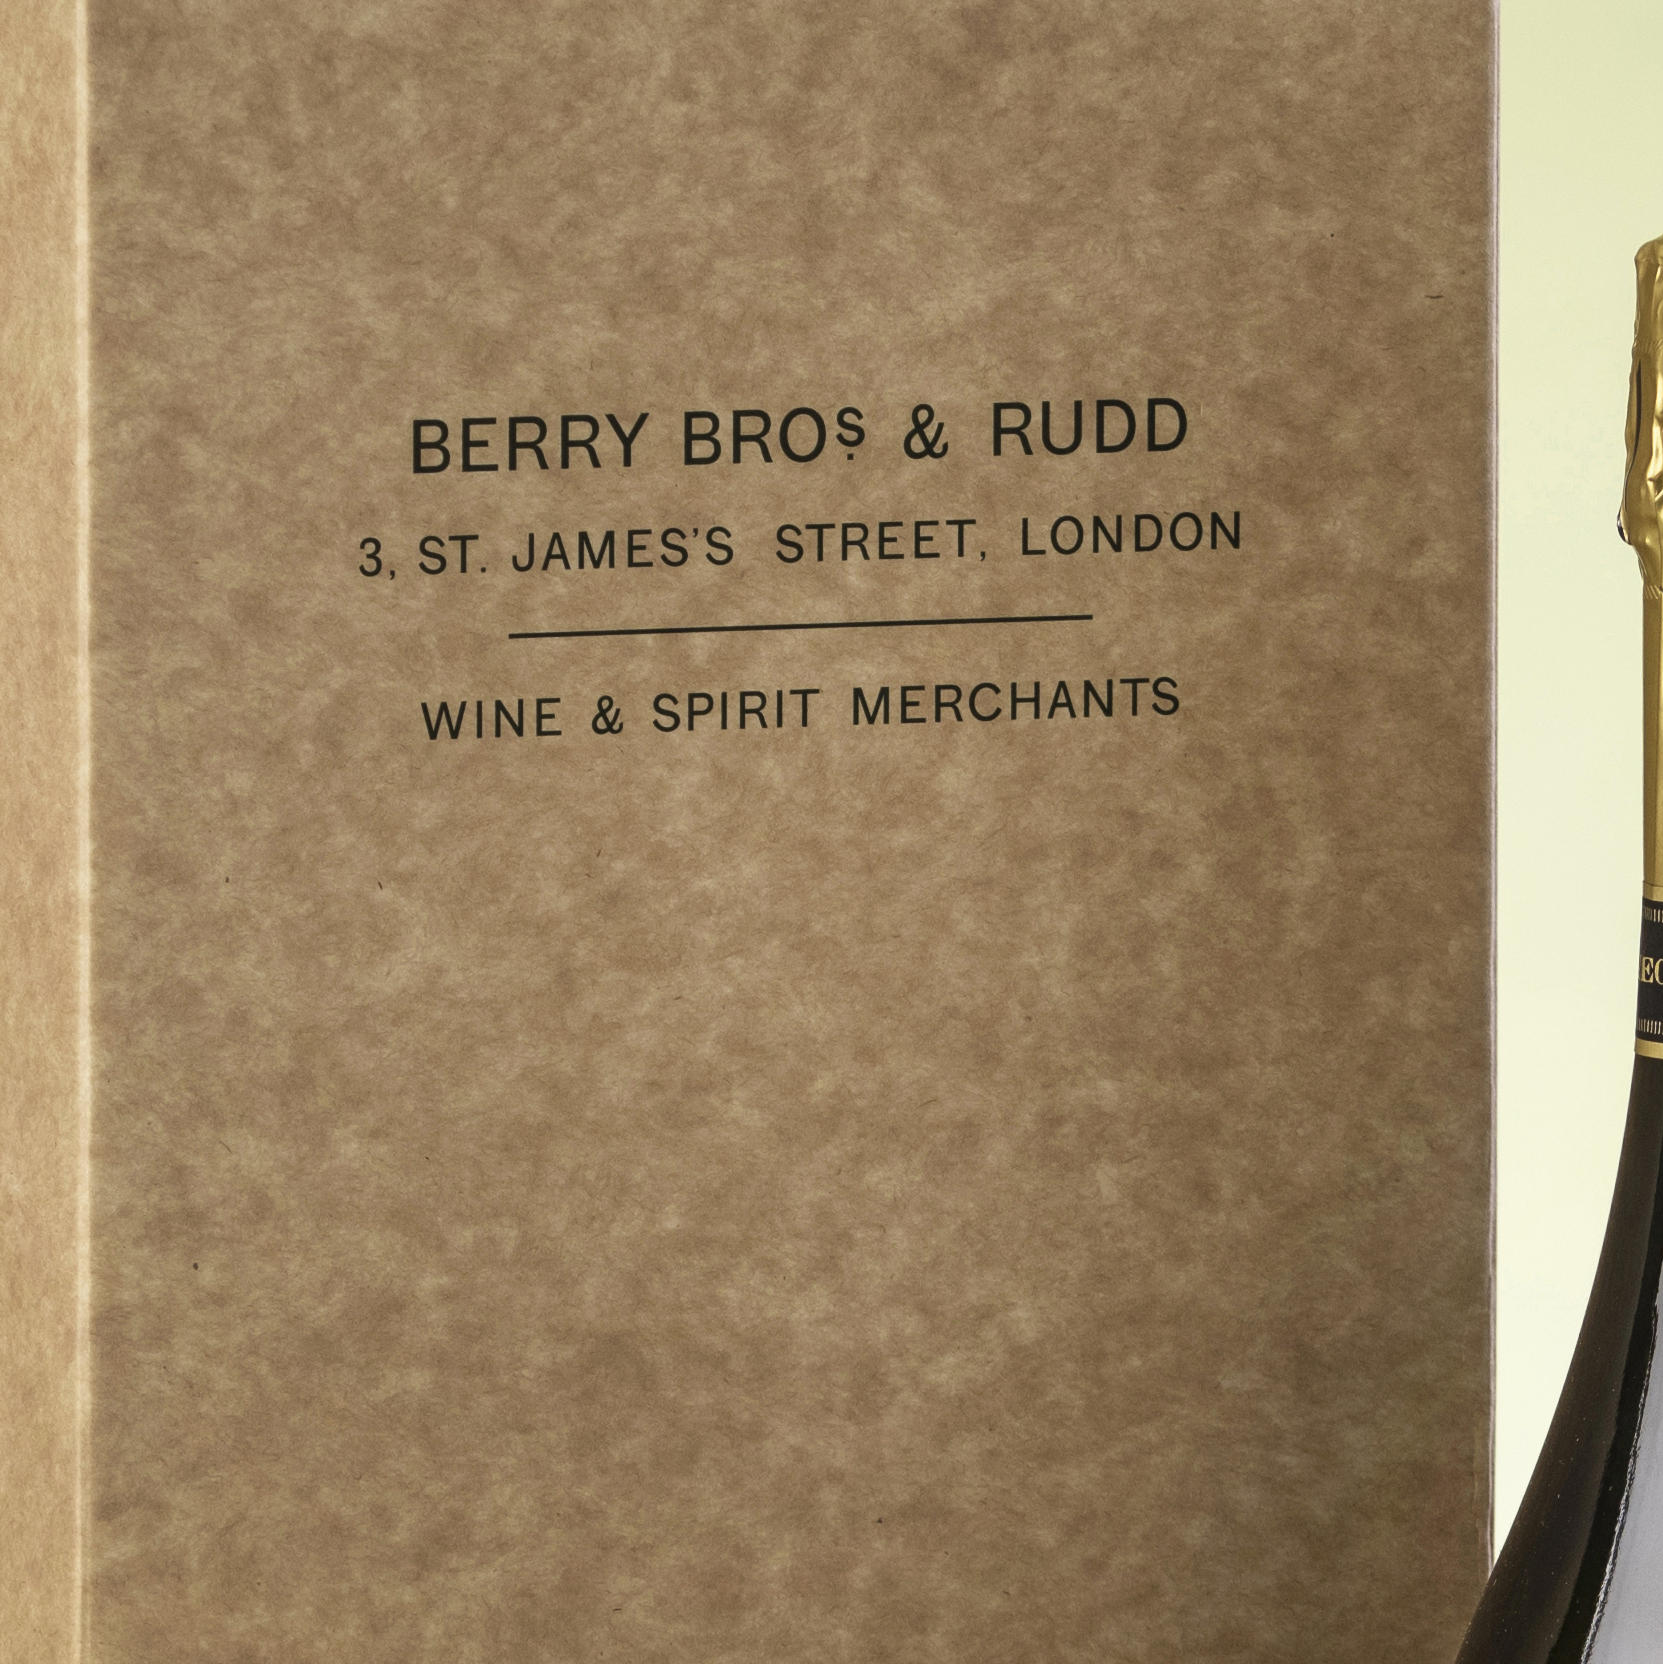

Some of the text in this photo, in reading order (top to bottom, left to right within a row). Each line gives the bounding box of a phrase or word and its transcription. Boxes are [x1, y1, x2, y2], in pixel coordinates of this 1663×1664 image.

[413, 413, 649, 473] BERRY
[904, 404, 948, 459] &
[994, 398, 1187, 456] RUDD
[359, 511, 1240, 580] 3, ST. JAMES'S STREET, LONDON
[421, 677, 1179, 740] WINE & SPIRIT MERCHANTS
